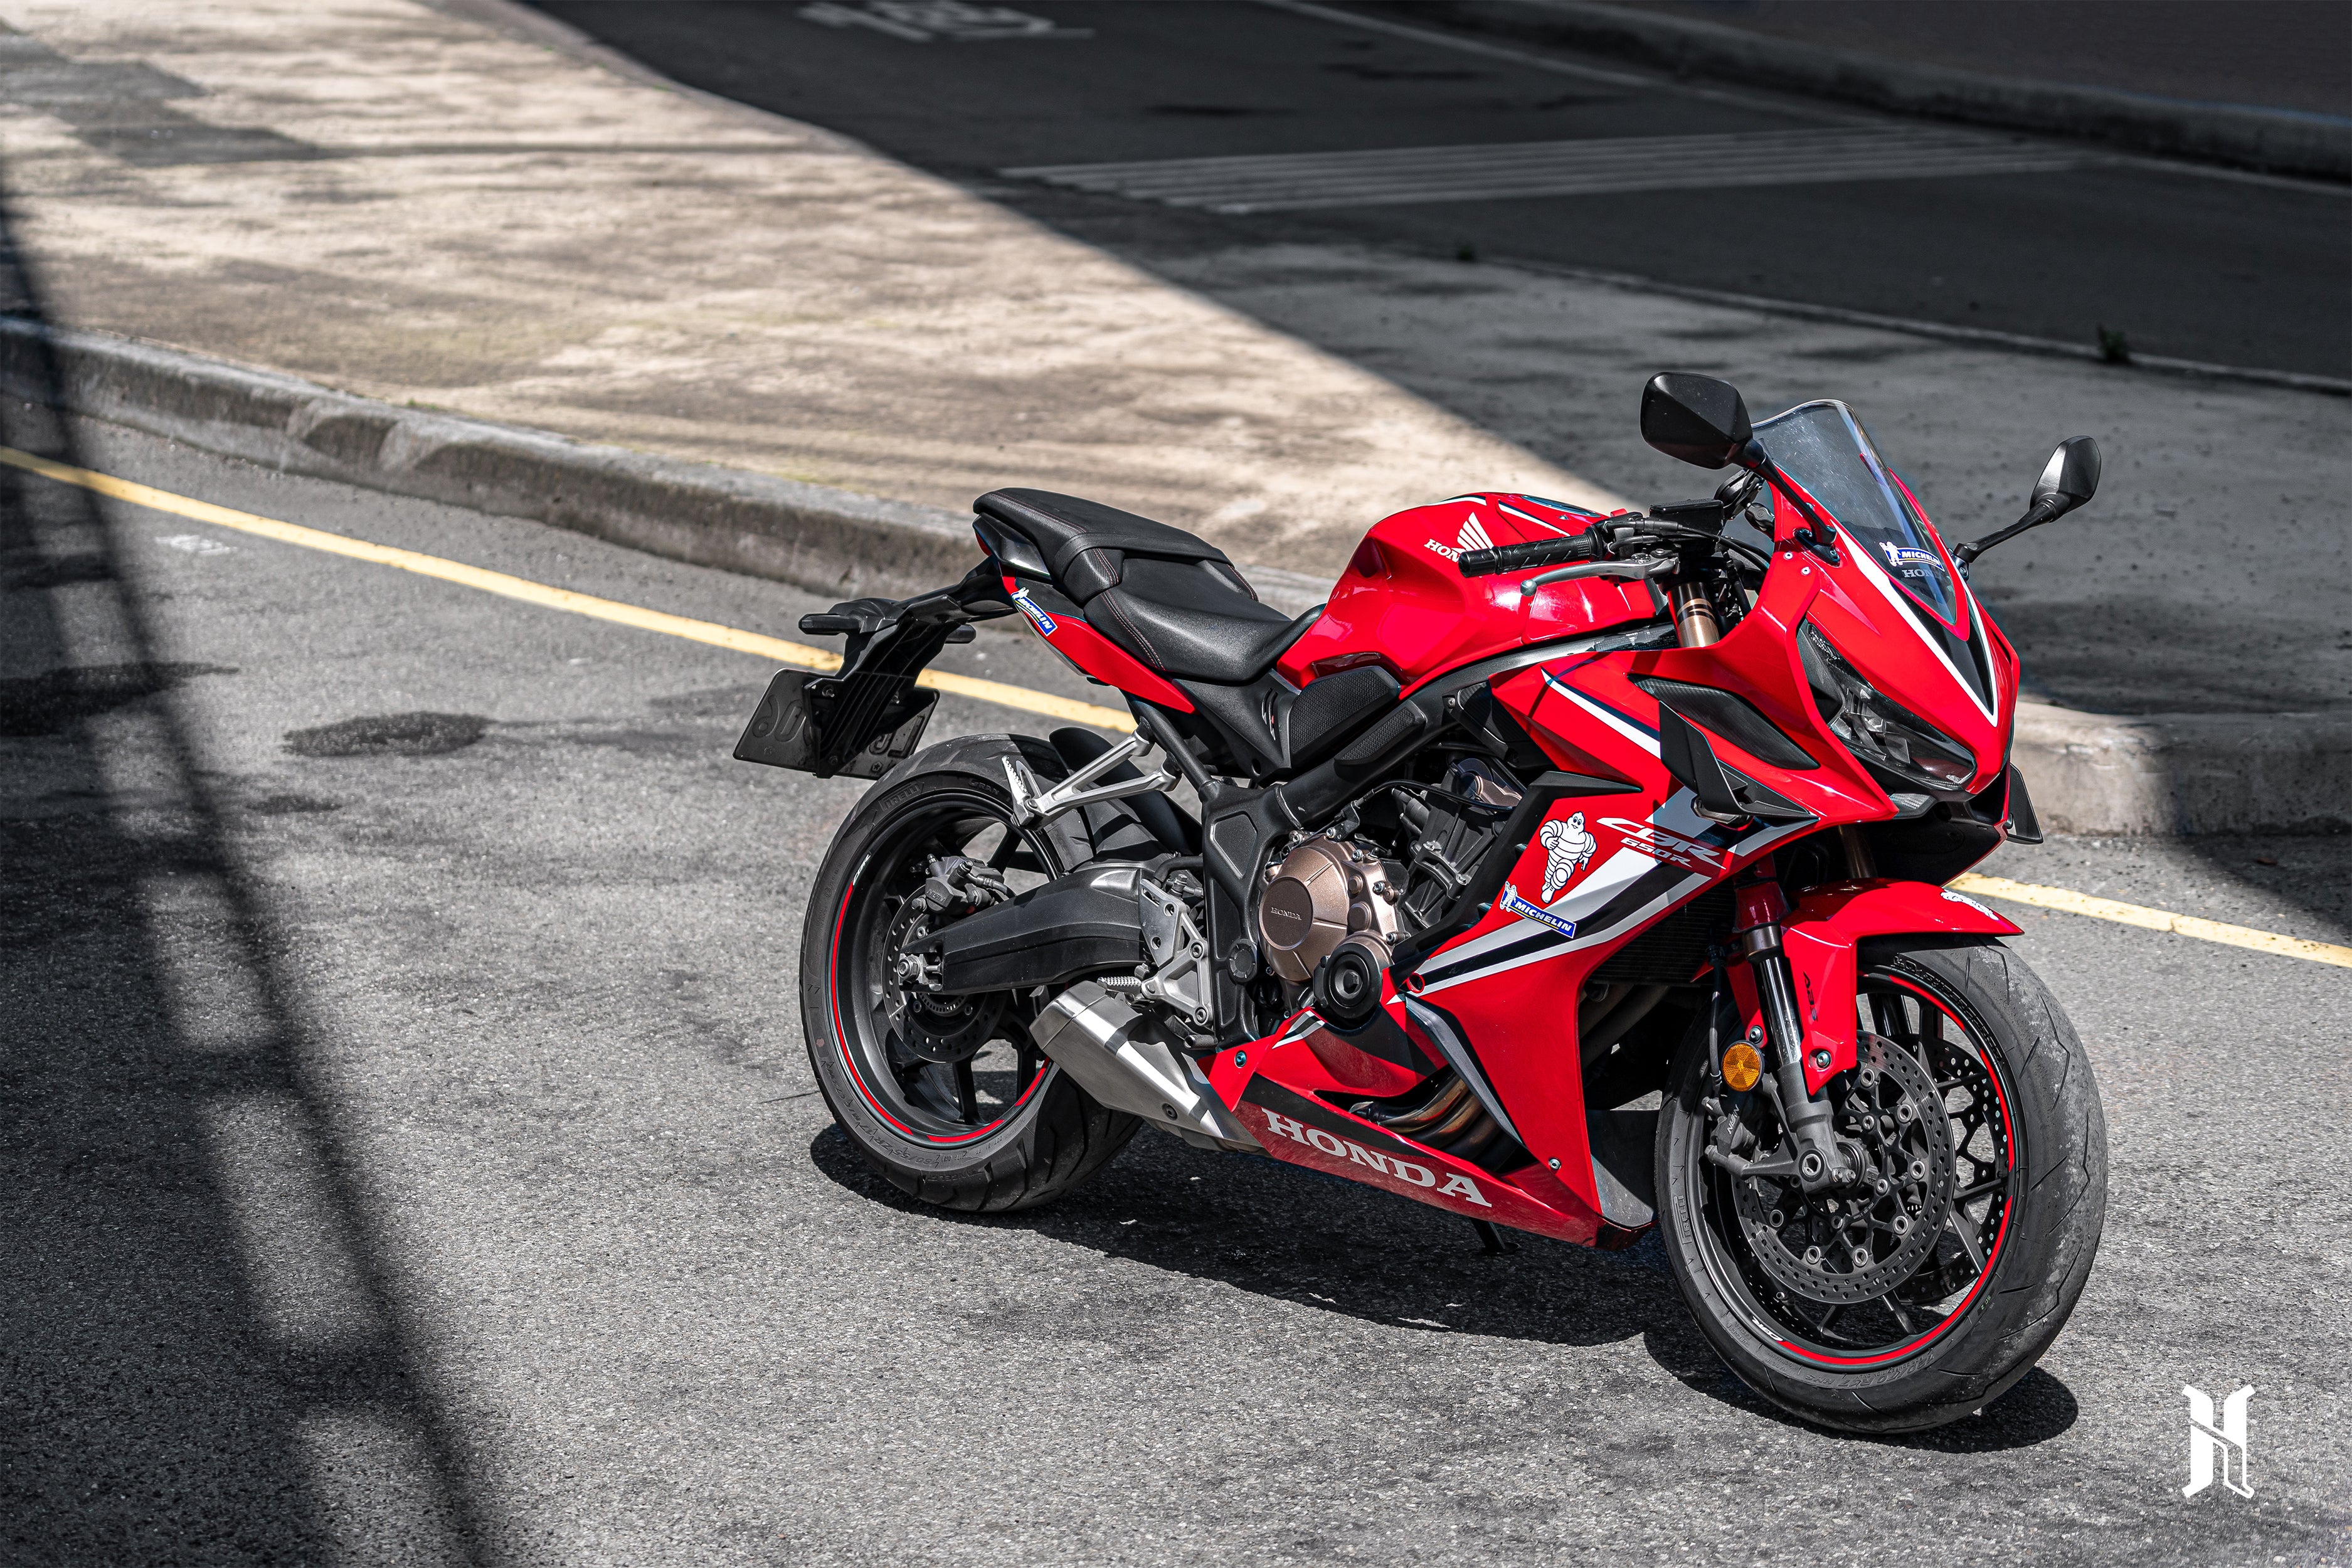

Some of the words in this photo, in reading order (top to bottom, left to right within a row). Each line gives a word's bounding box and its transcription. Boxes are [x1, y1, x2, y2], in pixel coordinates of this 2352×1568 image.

[1424, 539, 1460, 562] HON
[1901, 551, 1941, 566] MICHELIN
[1596, 817, 1726, 870] CBR
[1620, 837, 1692, 868] 650R
[1271, 907, 1302, 920] HONDA
[1515, 901, 1572, 931] MICHELIN
[1261, 1108, 1492, 1207] HONDA
[1673, 1195, 1692, 1244] PIRELLI
